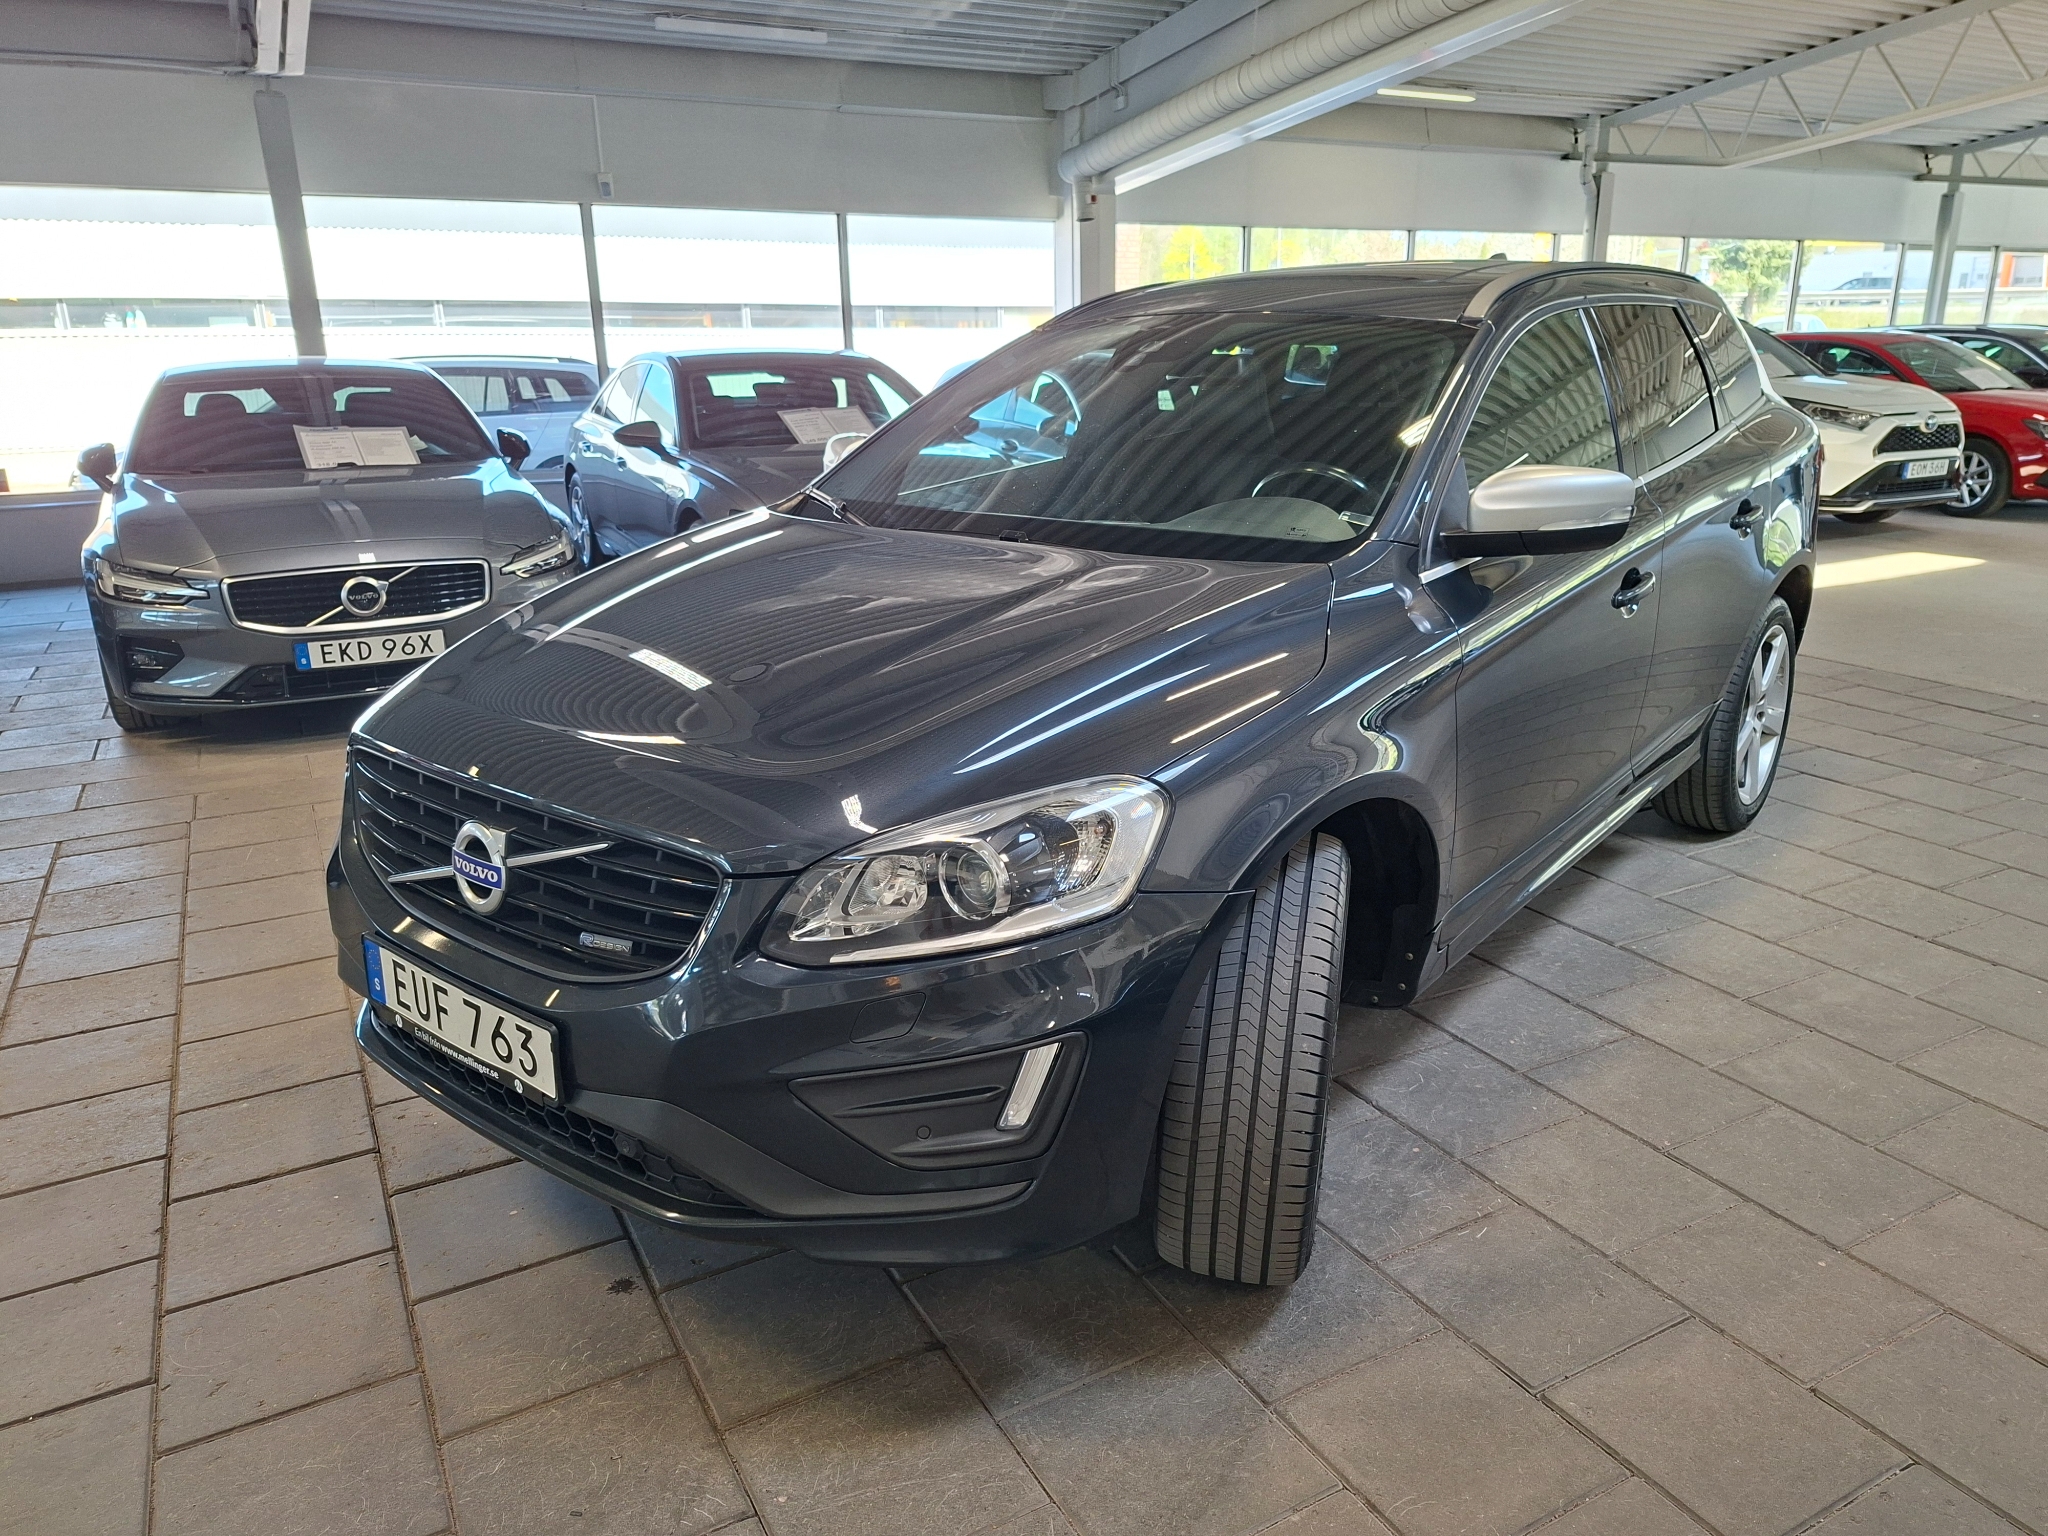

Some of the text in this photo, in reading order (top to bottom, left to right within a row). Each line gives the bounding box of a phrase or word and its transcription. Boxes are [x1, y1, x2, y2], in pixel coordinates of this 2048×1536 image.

[320, 633, 434, 664] EKD 96X
[454, 855, 499, 883] VOLVO
[374, 978, 381, 991] S
[391, 958, 538, 1078] EUF 763
[441, 1044, 500, 1080] www.mellinger.se
